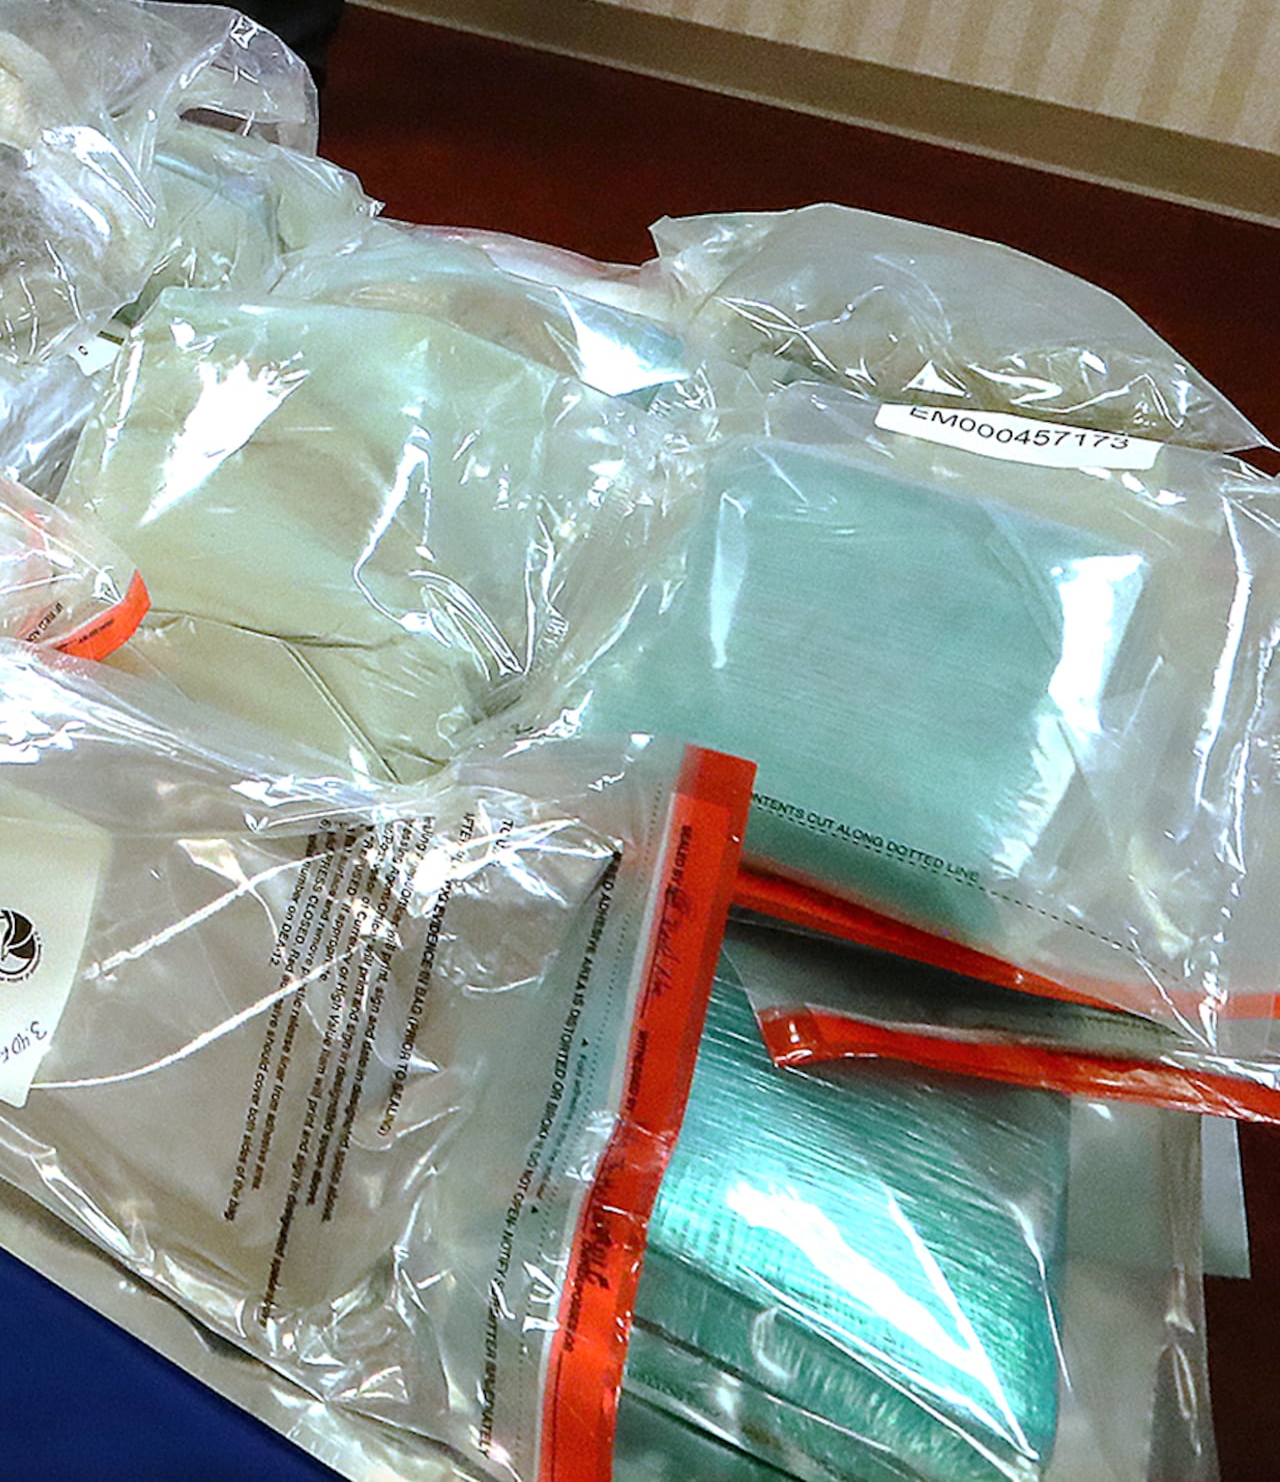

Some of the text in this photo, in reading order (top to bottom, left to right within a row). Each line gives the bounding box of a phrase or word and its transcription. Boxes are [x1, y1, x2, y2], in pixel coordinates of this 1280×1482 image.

[908, 405, 1131, 452] EM000457173
[749, 793, 979, 883] NTENTS CUT ALONG DOTTED LINE
[311, 852, 332, 893] PRESS
[328, 854, 348, 896] surface
[268, 859, 311, 969] number on DEA-12.
[292, 893, 319, 947] CLOSED.
[320, 898, 334, 921] and
[584, 891, 610, 956] ADHESIVE
[304, 921, 327, 966] remove
[340, 909, 367, 965] Currency
[419, 903, 445, 969] EVIDENCE
[284, 949, 301, 973] Red
[373, 950, 394, 985] print,
[574, 956, 592, 991] AREA
[329, 982, 348, 1011] High
[353, 966, 372, 995] print
[348, 998, 364, 1021] and
[366, 985, 385, 1013] sign
[409, 987, 426, 1014] BAG
[571, 992, 585, 1007] IS
[280, 1009, 302, 1053] release
[322, 1012, 342, 1047] Value
[340, 1023, 358, 1050] sign
[363, 1014, 380, 1039] and
[397, 1016, 418, 1060] (PRIOR
[552, 1007, 580, 1078] DISTORTED
[256, 1029, 278, 1071] should
[357, 1040, 375, 1068] date
[274, 1053, 291, 1082] liner
[392, 1061, 407, 1080] TO
[248, 1071, 266, 1106] cover
[268, 1083, 284, 1112] from
[310, 1075, 325, 1097] will
[321, 1065, 349, 1132] designated
[549, 1080, 565, 1101] OR
[242, 1106, 260, 1133] both
[301, 1097, 321, 1129] print
[335, 1082, 364, 1148] designated
[236, 1134, 253, 1164] sides
[255, 1112, 279, 1163] adhesive
[297, 1129, 313, 1152] and
[312, 1133, 331, 1167] space
[289, 1152, 308, 1179] sign
[516, 1168, 534, 1191] NOT
[229, 1179, 243, 1198] the
[221, 1197, 239, 1223] bag.
[270, 1192, 300, 1257] designated
[491, 1230, 517, 1278] NOTIFY
